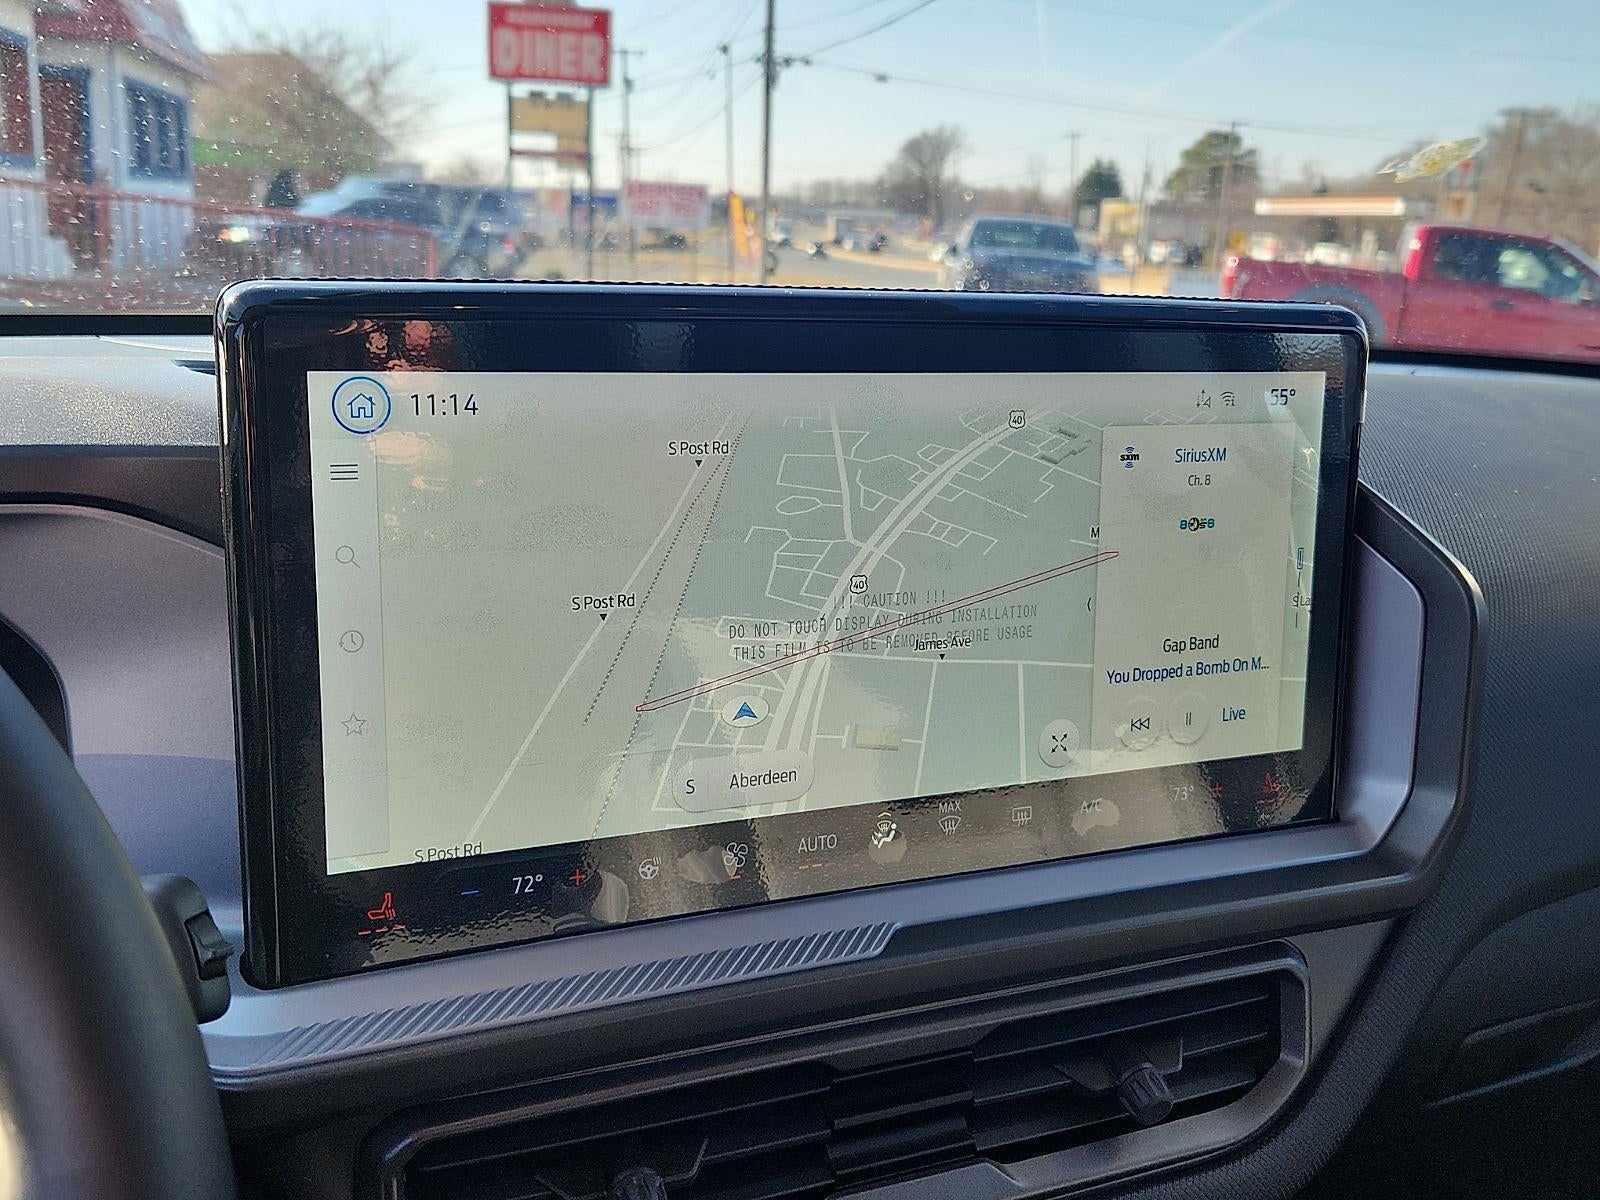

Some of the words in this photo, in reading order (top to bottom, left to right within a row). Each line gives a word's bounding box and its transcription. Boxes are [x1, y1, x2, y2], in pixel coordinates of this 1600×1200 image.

[494, 27, 604, 79] DINER
[410, 393, 479, 416] 11:14
[1269, 388, 1297, 406] 55°
[1011, 415, 1023, 425] 40
[668, 441, 677, 456] S
[680, 441, 710, 455] Post
[712, 440, 729, 455] Rd
[1174, 447, 1227, 463] SiriusXM
[1119, 453, 1140, 462] sxm
[1187, 474, 1203, 487] Ch.
[1204, 474, 1211, 486] 8
[852, 579, 865, 590] 40
[572, 596, 581, 611] S
[584, 595, 615, 610] Post
[617, 592, 635, 608] Rd
[863, 591, 917, 608] CAUTION
[729, 624, 745, 640] DO
[754, 622, 778, 637] NOT
[787, 619, 827, 635] TOUCH
[835, 614, 889, 632] DISPLAY
[897, 611, 944, 627] DURING
[951, 604, 1038, 623] INSTALLATION
[734, 645, 766, 661] THIS
[775, 642, 808, 658] FILM
[816, 640, 830, 655] IS
[840, 638, 854, 652] TO
[862, 637, 877, 651] BE
[997, 624, 1033, 640] USAGE
[914, 637, 949, 651] James
[950, 635, 972, 648] Ave
[1163, 638, 1186, 654] Gap
[1189, 634, 1220, 651] Band
[1107, 669, 1130, 684] You
[1132, 663, 1183, 682] Dropped
[1185, 665, 1193, 677] a
[1196, 659, 1230, 676] Bomb
[1232, 658, 1249, 672] On
[1222, 706, 1246, 722] Live
[685, 779, 696, 795] S
[729, 769, 797, 790] Aberdeen
[1172, 785, 1195, 801] 73°
[938, 800, 962, 814] MAX
[1080, 797, 1103, 814] A/C
[427, 845, 460, 861] Post
[463, 842, 482, 858] Rd
[798, 833, 838, 854] AUTO
[512, 873, 544, 895] 72°
